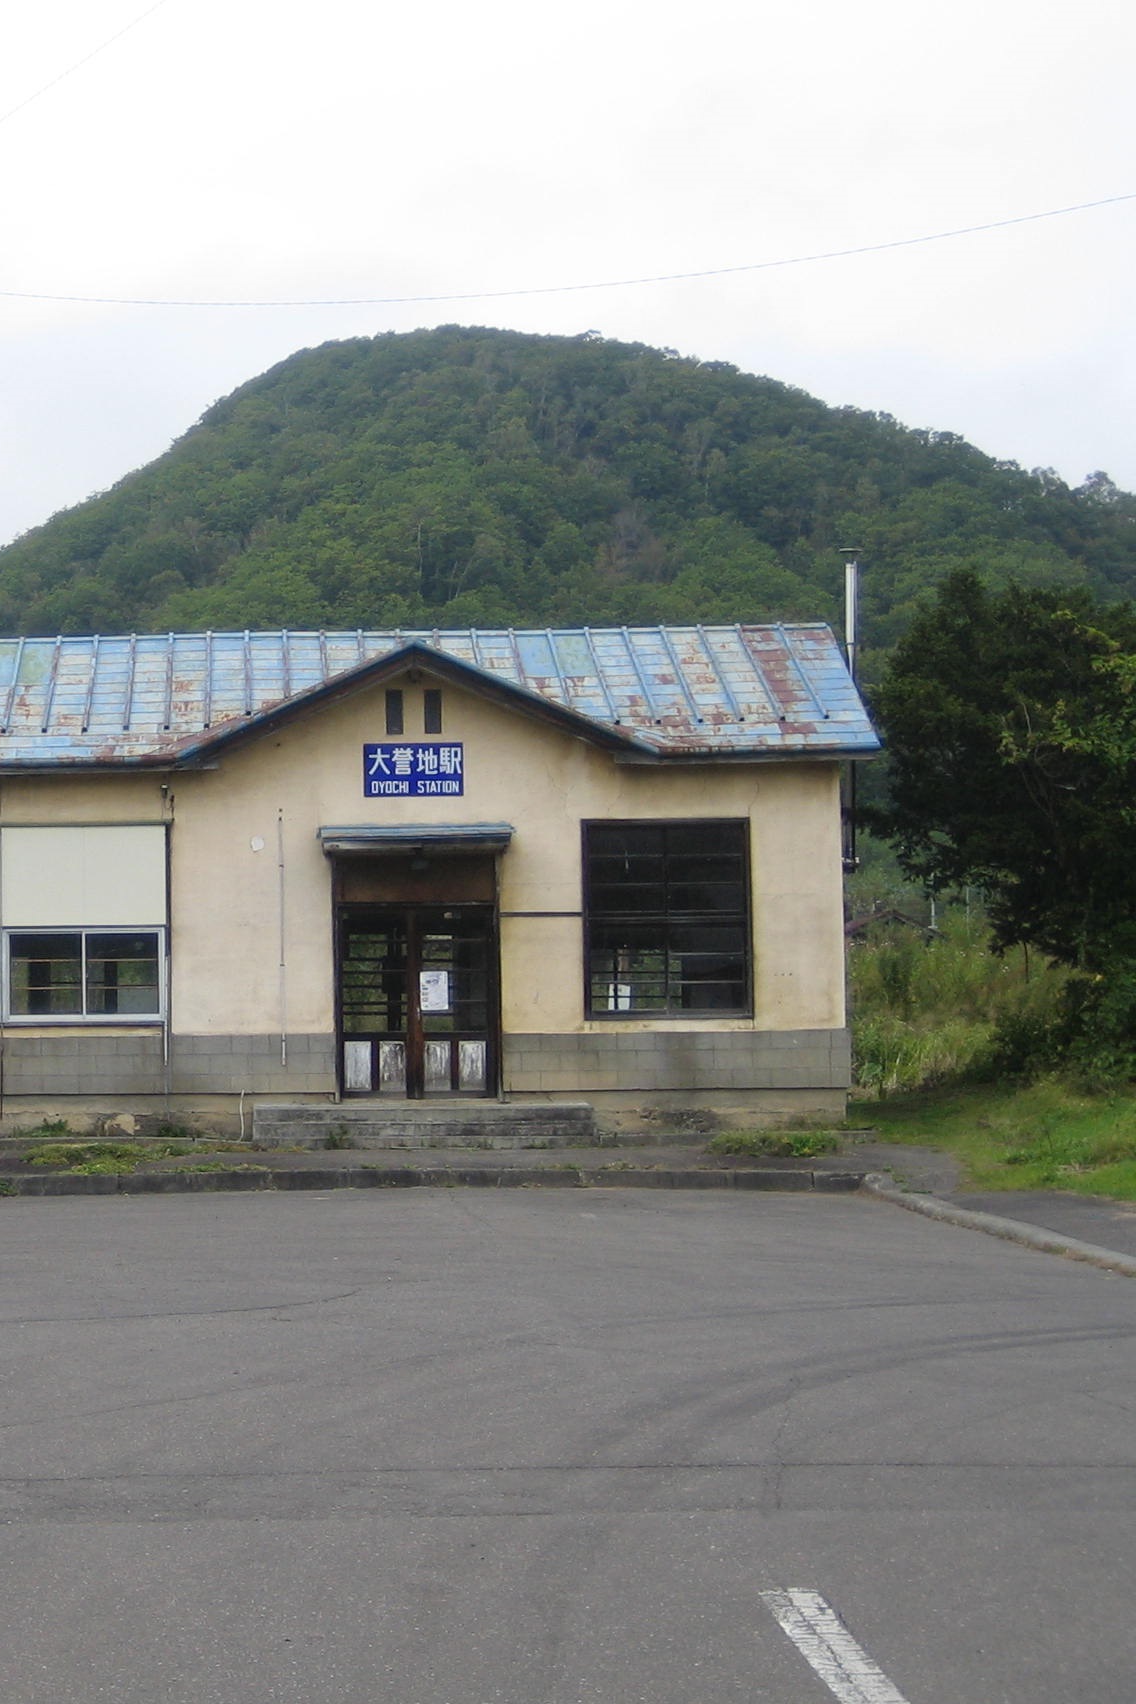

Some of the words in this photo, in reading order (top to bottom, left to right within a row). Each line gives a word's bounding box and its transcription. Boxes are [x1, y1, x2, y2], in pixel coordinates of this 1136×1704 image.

[368, 747, 462, 775] 大誉地駅
[371, 780, 409, 794] OYOCHI
[417, 780, 460, 793] STATION
